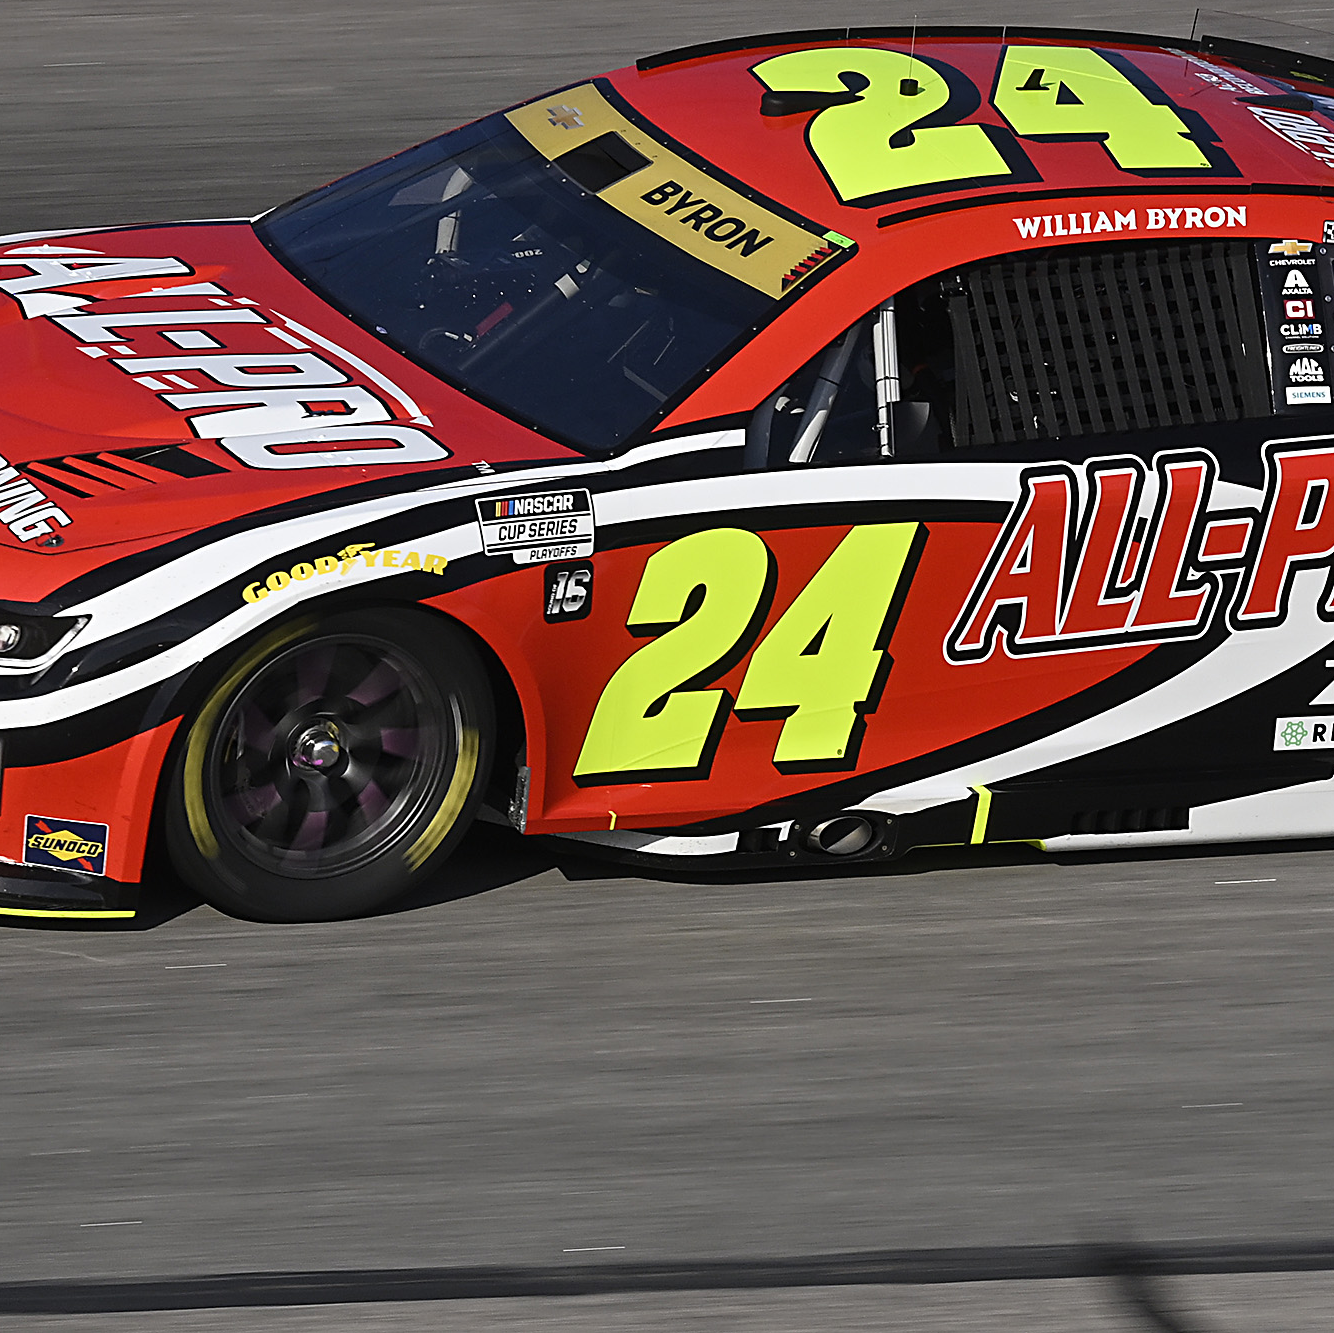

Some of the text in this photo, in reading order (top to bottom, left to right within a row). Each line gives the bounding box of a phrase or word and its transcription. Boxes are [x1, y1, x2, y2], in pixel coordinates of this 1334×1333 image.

[750, 44, 1232, 207] 24
[639, 179, 776, 259] BYRON
[1012, 205, 1248, 240] WILLIAM BYRON
[1269, 258, 1316, 266] CHEVROLET
[1281, 287, 1314, 296] AXALTA
[1285, 300, 1314, 318] CI
[1280, 323, 1323, 336] CLIMB
[1289, 357, 1324, 375] MAC
[1289, 374, 1325, 383] TOOLS
[1291, 391, 1327, 399] SIEMENS
[514, 494, 574, 515] NASCAR
[498, 518, 578, 541] CUP SERIES
[529, 545, 578, 561] PLAYOFFS
[551, 569, 592, 614] 16
[572, 521, 929, 784] 24
[30, 836, 100, 856] SUNOCO
